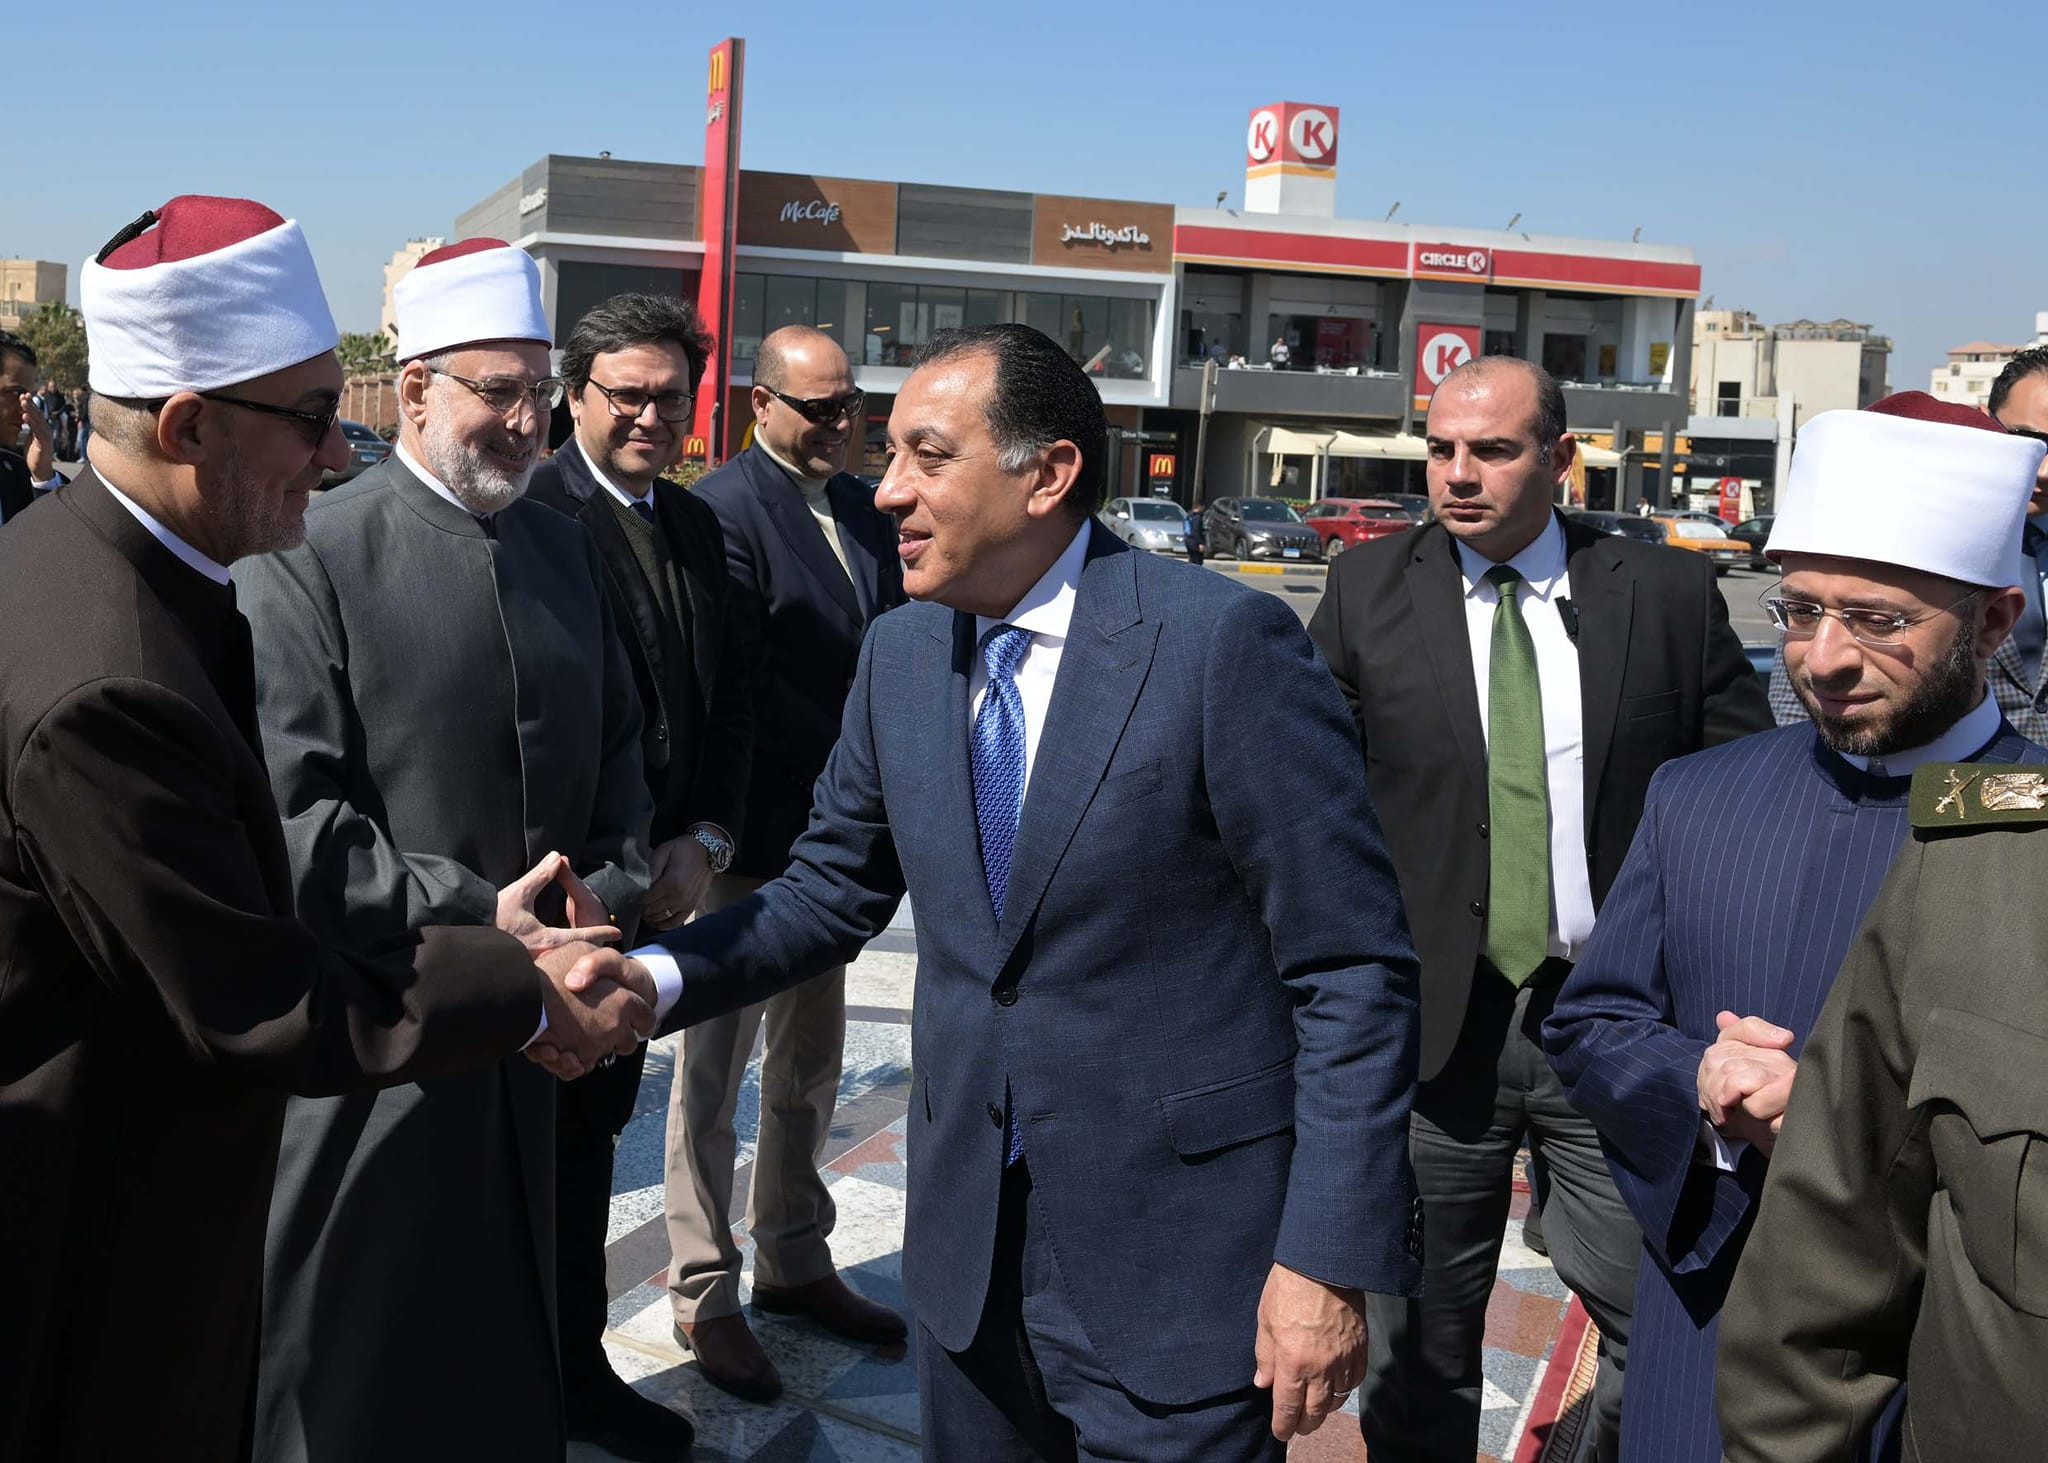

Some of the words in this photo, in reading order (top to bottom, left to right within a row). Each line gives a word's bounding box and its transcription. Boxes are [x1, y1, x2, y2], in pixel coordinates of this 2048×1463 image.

[1255, 120, 1274, 154] K
[1303, 119, 1330, 155] K
[780, 199, 840, 226] McCafé
[1060, 221, 1150, 246] ماكدونالدز
[1420, 252, 1467, 268] CIRCLE
[1437, 345, 1463, 375] K
